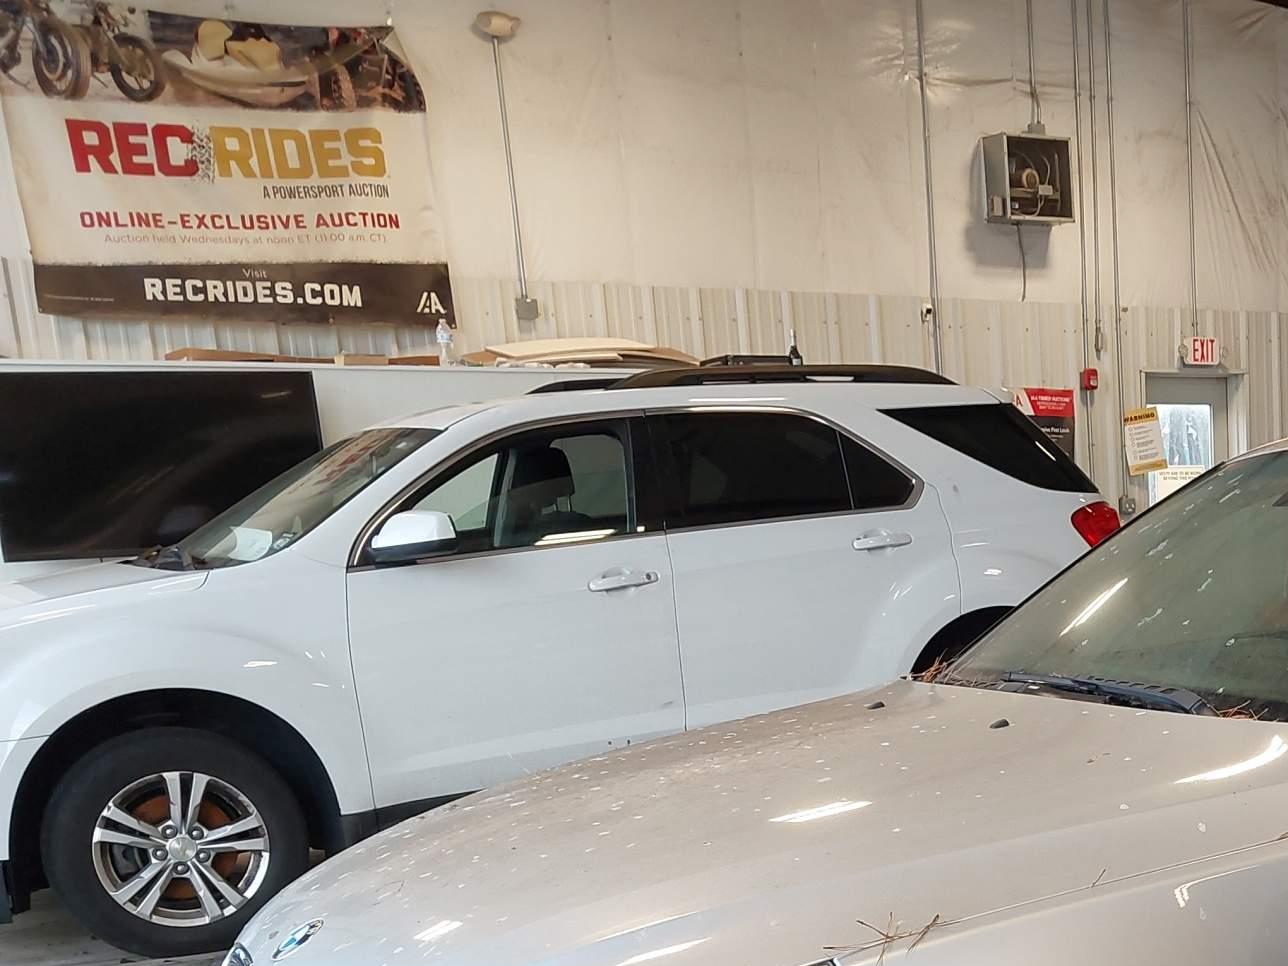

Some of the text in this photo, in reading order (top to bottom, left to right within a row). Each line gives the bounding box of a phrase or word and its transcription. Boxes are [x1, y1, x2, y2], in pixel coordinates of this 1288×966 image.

[65, 119, 387, 179] REC RIDES
[263, 183, 390, 199] A POWERSPORT AUCTION
[79, 211, 401, 230] ONLINE-EXCLUSIVE AUCTION
[104, 234, 150, 243] Auction
[153, 234, 177, 244] held
[180, 235, 249, 245] Wednesdays
[253, 236, 263, 244] at
[266, 236, 295, 244] noon
[242, 267, 267, 279] Visit
[143, 277, 363, 307] RECRIDES.COM
[1192, 338, 1215, 362] EXIT
[1123, 412, 1155, 423] WARNING
